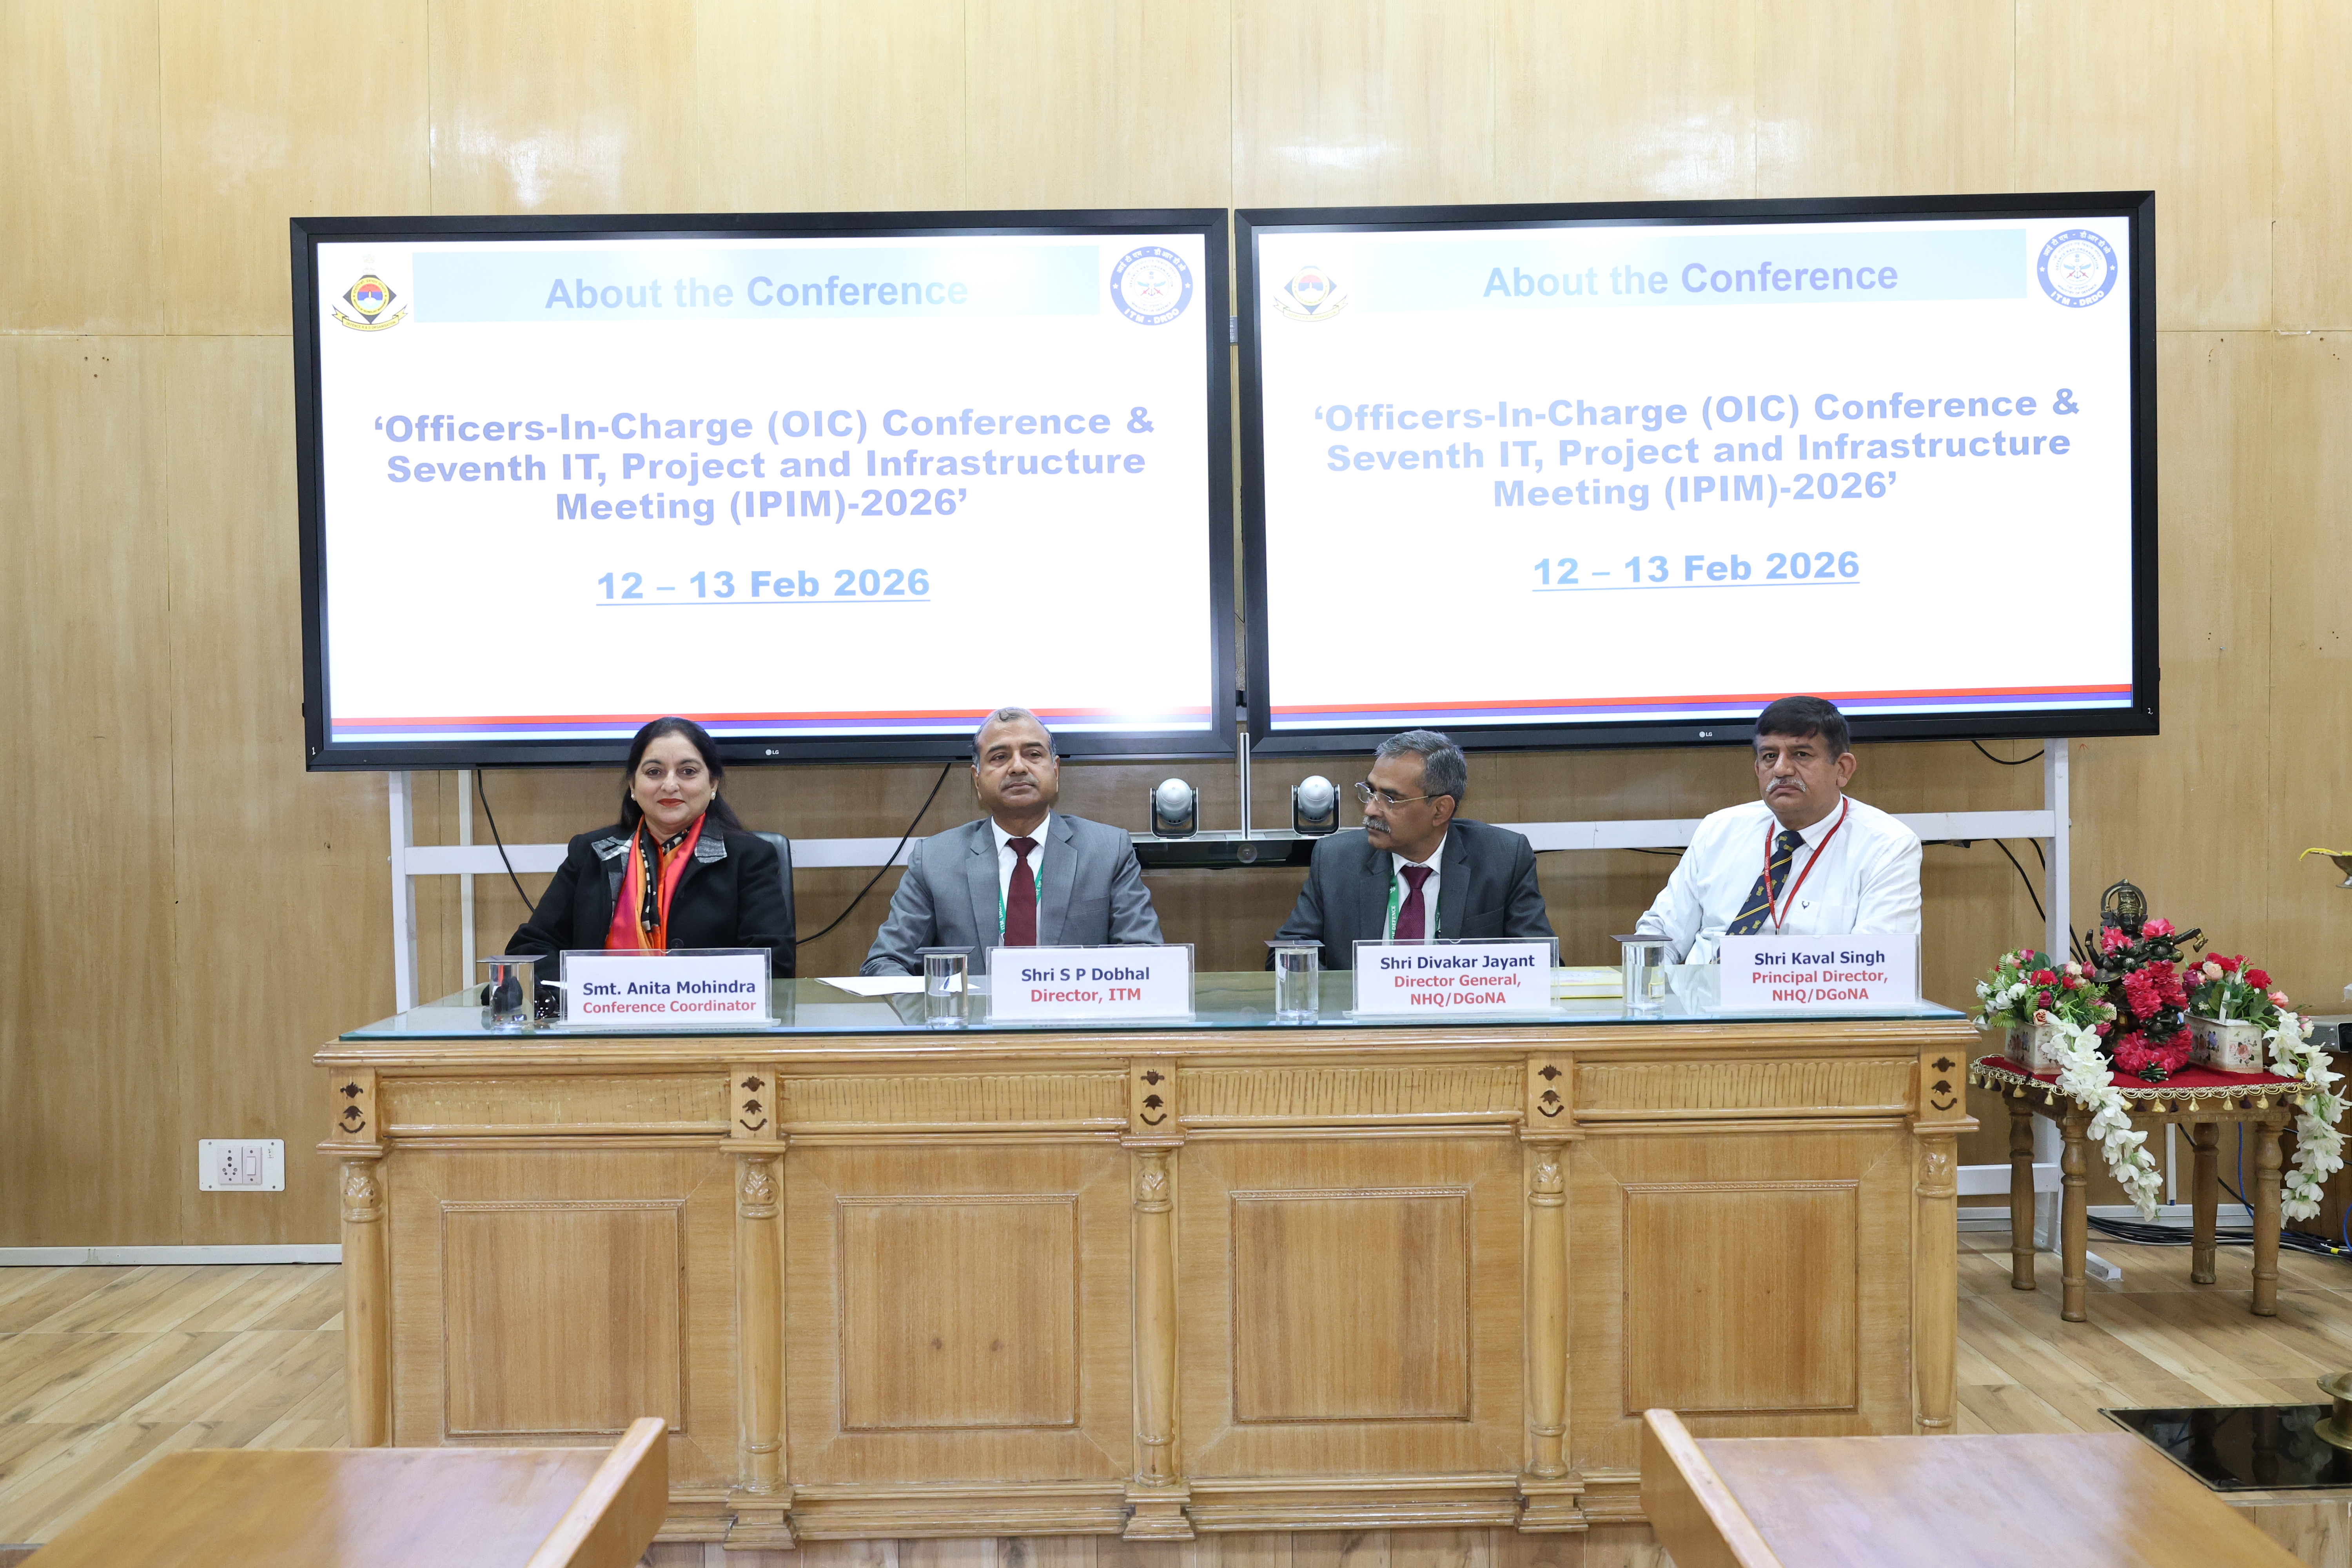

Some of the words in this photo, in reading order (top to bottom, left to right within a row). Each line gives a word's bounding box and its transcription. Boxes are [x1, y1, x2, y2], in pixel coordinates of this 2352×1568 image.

[2056, 253, 2065, 270] DEFENCE
[2077, 248, 2098, 269] ORGANISATION
[1483, 267, 1598, 297] About
[1610, 265, 1668, 295] the
[1681, 261, 1898, 292] Conference
[544, 278, 662, 309] About
[673, 277, 733, 308] the
[747, 275, 968, 307] Conference
[2058, 285, 2074, 294] MINISTRY
[2082, 284, 2096, 294] DEFENCE
[2051, 291, 2070, 305] ITM
[2079, 290, 2104, 306] DRDO
[1124, 308, 1144, 323] ITM
[1153, 308, 1179, 323] DRDO
[1702, 394, 1799, 431] (OIC)
[1815, 392, 2037, 421] Conference
[2053, 388, 2080, 415] &
[768, 409, 867, 445] (OIC)
[883, 408, 1111, 436] Conference
[1127, 406, 1155, 434] &
[1327, 442, 1484, 472] Seventh
[1500, 440, 1543, 474] IT,
[1559, 437, 1699, 472] Project
[1714, 435, 1782, 463] and
[1799, 430, 2071, 461] Infrastructure
[387, 454, 546, 483] Seventh
[563, 453, 606, 487] IT,
[622, 452, 765, 486] Project
[780, 450, 850, 478] and
[867, 448, 1145, 476] Infrastructure
[1494, 478, 1649, 511] Meeting
[557, 492, 714, 526] Meeting
[1534, 557, 1579, 585] 12
[1625, 555, 1669, 583] 13
[1684, 554, 1752, 581] Feb
[1766, 551, 1859, 579] 2026
[598, 572, 643, 599] 12
[690, 570, 735, 598] 13
[751, 570, 820, 597] Feb
[834, 568, 929, 596] 2026
[1381, 956, 1411, 969] Shri
[1418, 956, 1478, 969] Divakar
[1482, 955, 1535, 970] Jayant
[1755, 952, 1786, 965] Shri
[1792, 951, 1834, 964] Kaval
[1840, 950, 1885, 966] Singh
[1022, 968, 1054, 982] Shri
[1060, 968, 1070, 981] S
[1076, 968, 1086, 980] P
[1092, 967, 1149, 980] Dobhal
[1395, 976, 1455, 987] Director
[1459, 973, 1521, 987] General,
[1753, 971, 1817, 985] Principal
[1823, 970, 1887, 983] Director,
[583, 983, 621, 995] Smt.
[627, 981, 670, 995] Anita
[677, 980, 755, 994] Mohindra
[1031, 989, 1102, 1004] Director,
[1109, 988, 1140, 1000] ITM
[1411, 992, 1506, 1007] NHQ/DGoNA
[1773, 988, 1869, 1004] NHQ/DGoNA
[583, 1002, 665, 1013] Conference
[670, 1000, 756, 1012] Coordinator
